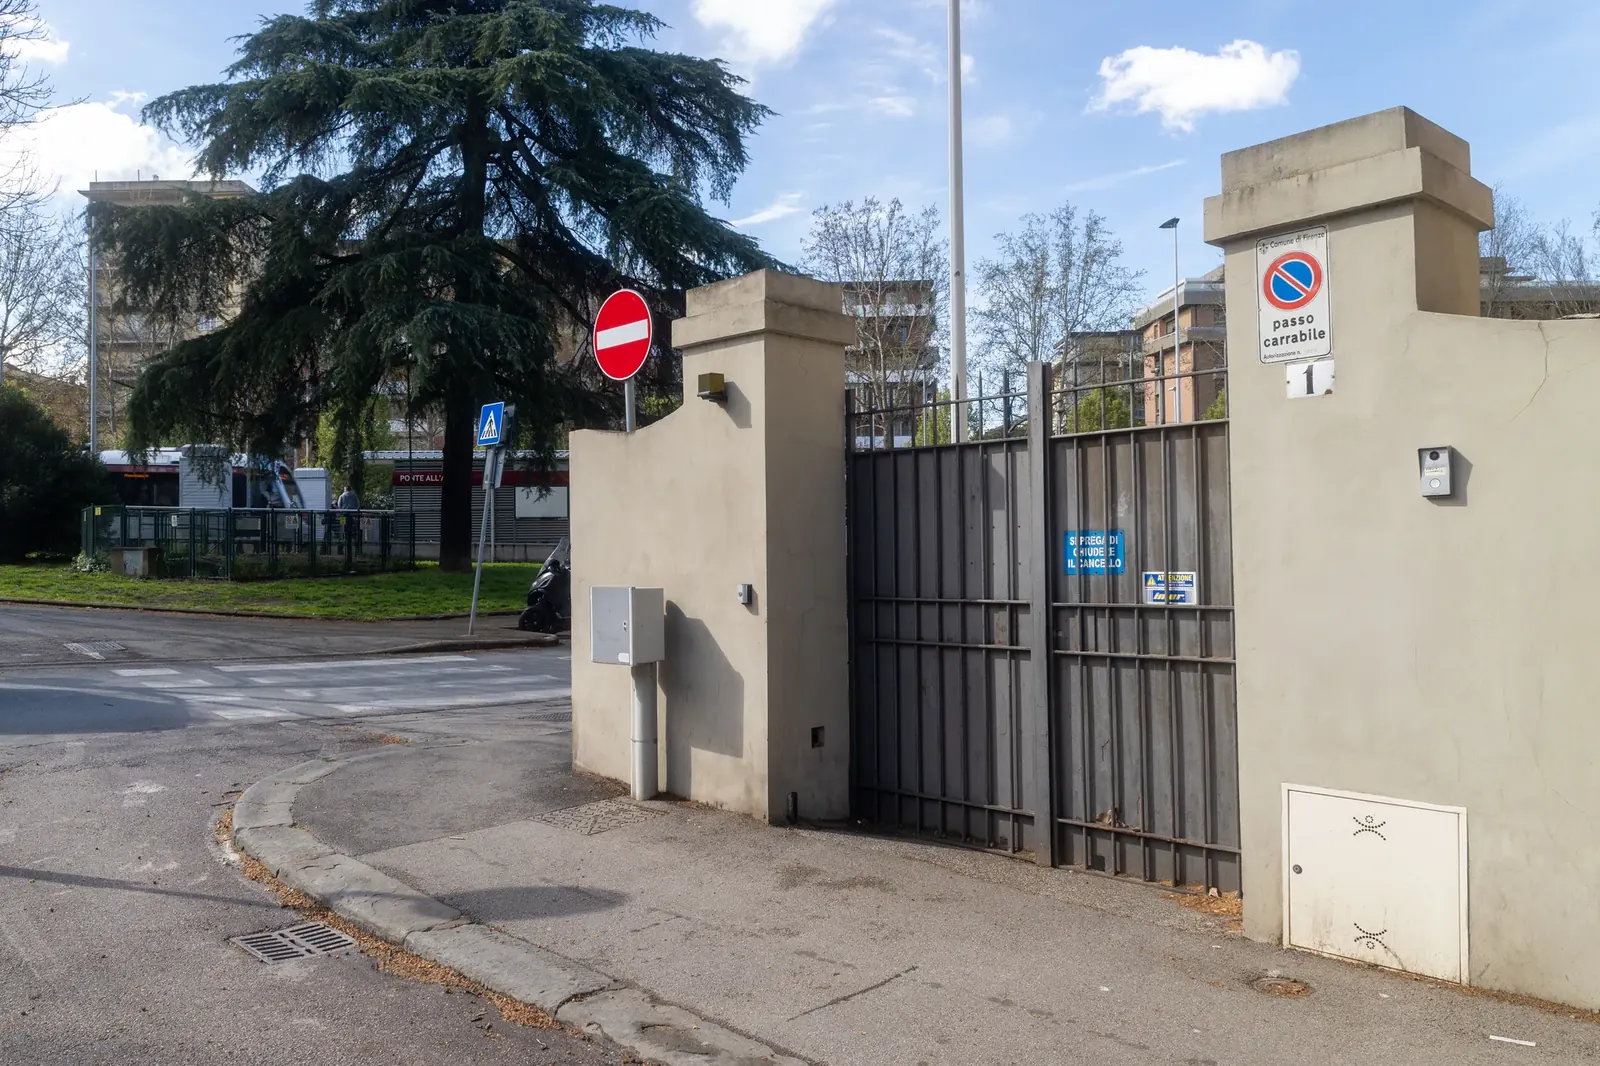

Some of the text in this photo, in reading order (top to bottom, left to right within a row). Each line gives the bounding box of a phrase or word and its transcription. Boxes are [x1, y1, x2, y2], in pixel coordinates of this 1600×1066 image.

[1270, 232, 1325, 248] Comune di Firenze
[1273, 314, 1314, 332] passo
[1263, 328, 1326, 348] carrabile
[1302, 364, 1315, 395] 1
[400, 474, 424, 482] PONTE
[1109, 535, 1118, 545] DI
[1073, 547, 1115, 557] CHIUDEE
[1067, 558, 1121, 568] IL ANCELO
[1157, 574, 1193, 582] ATENZIONE
